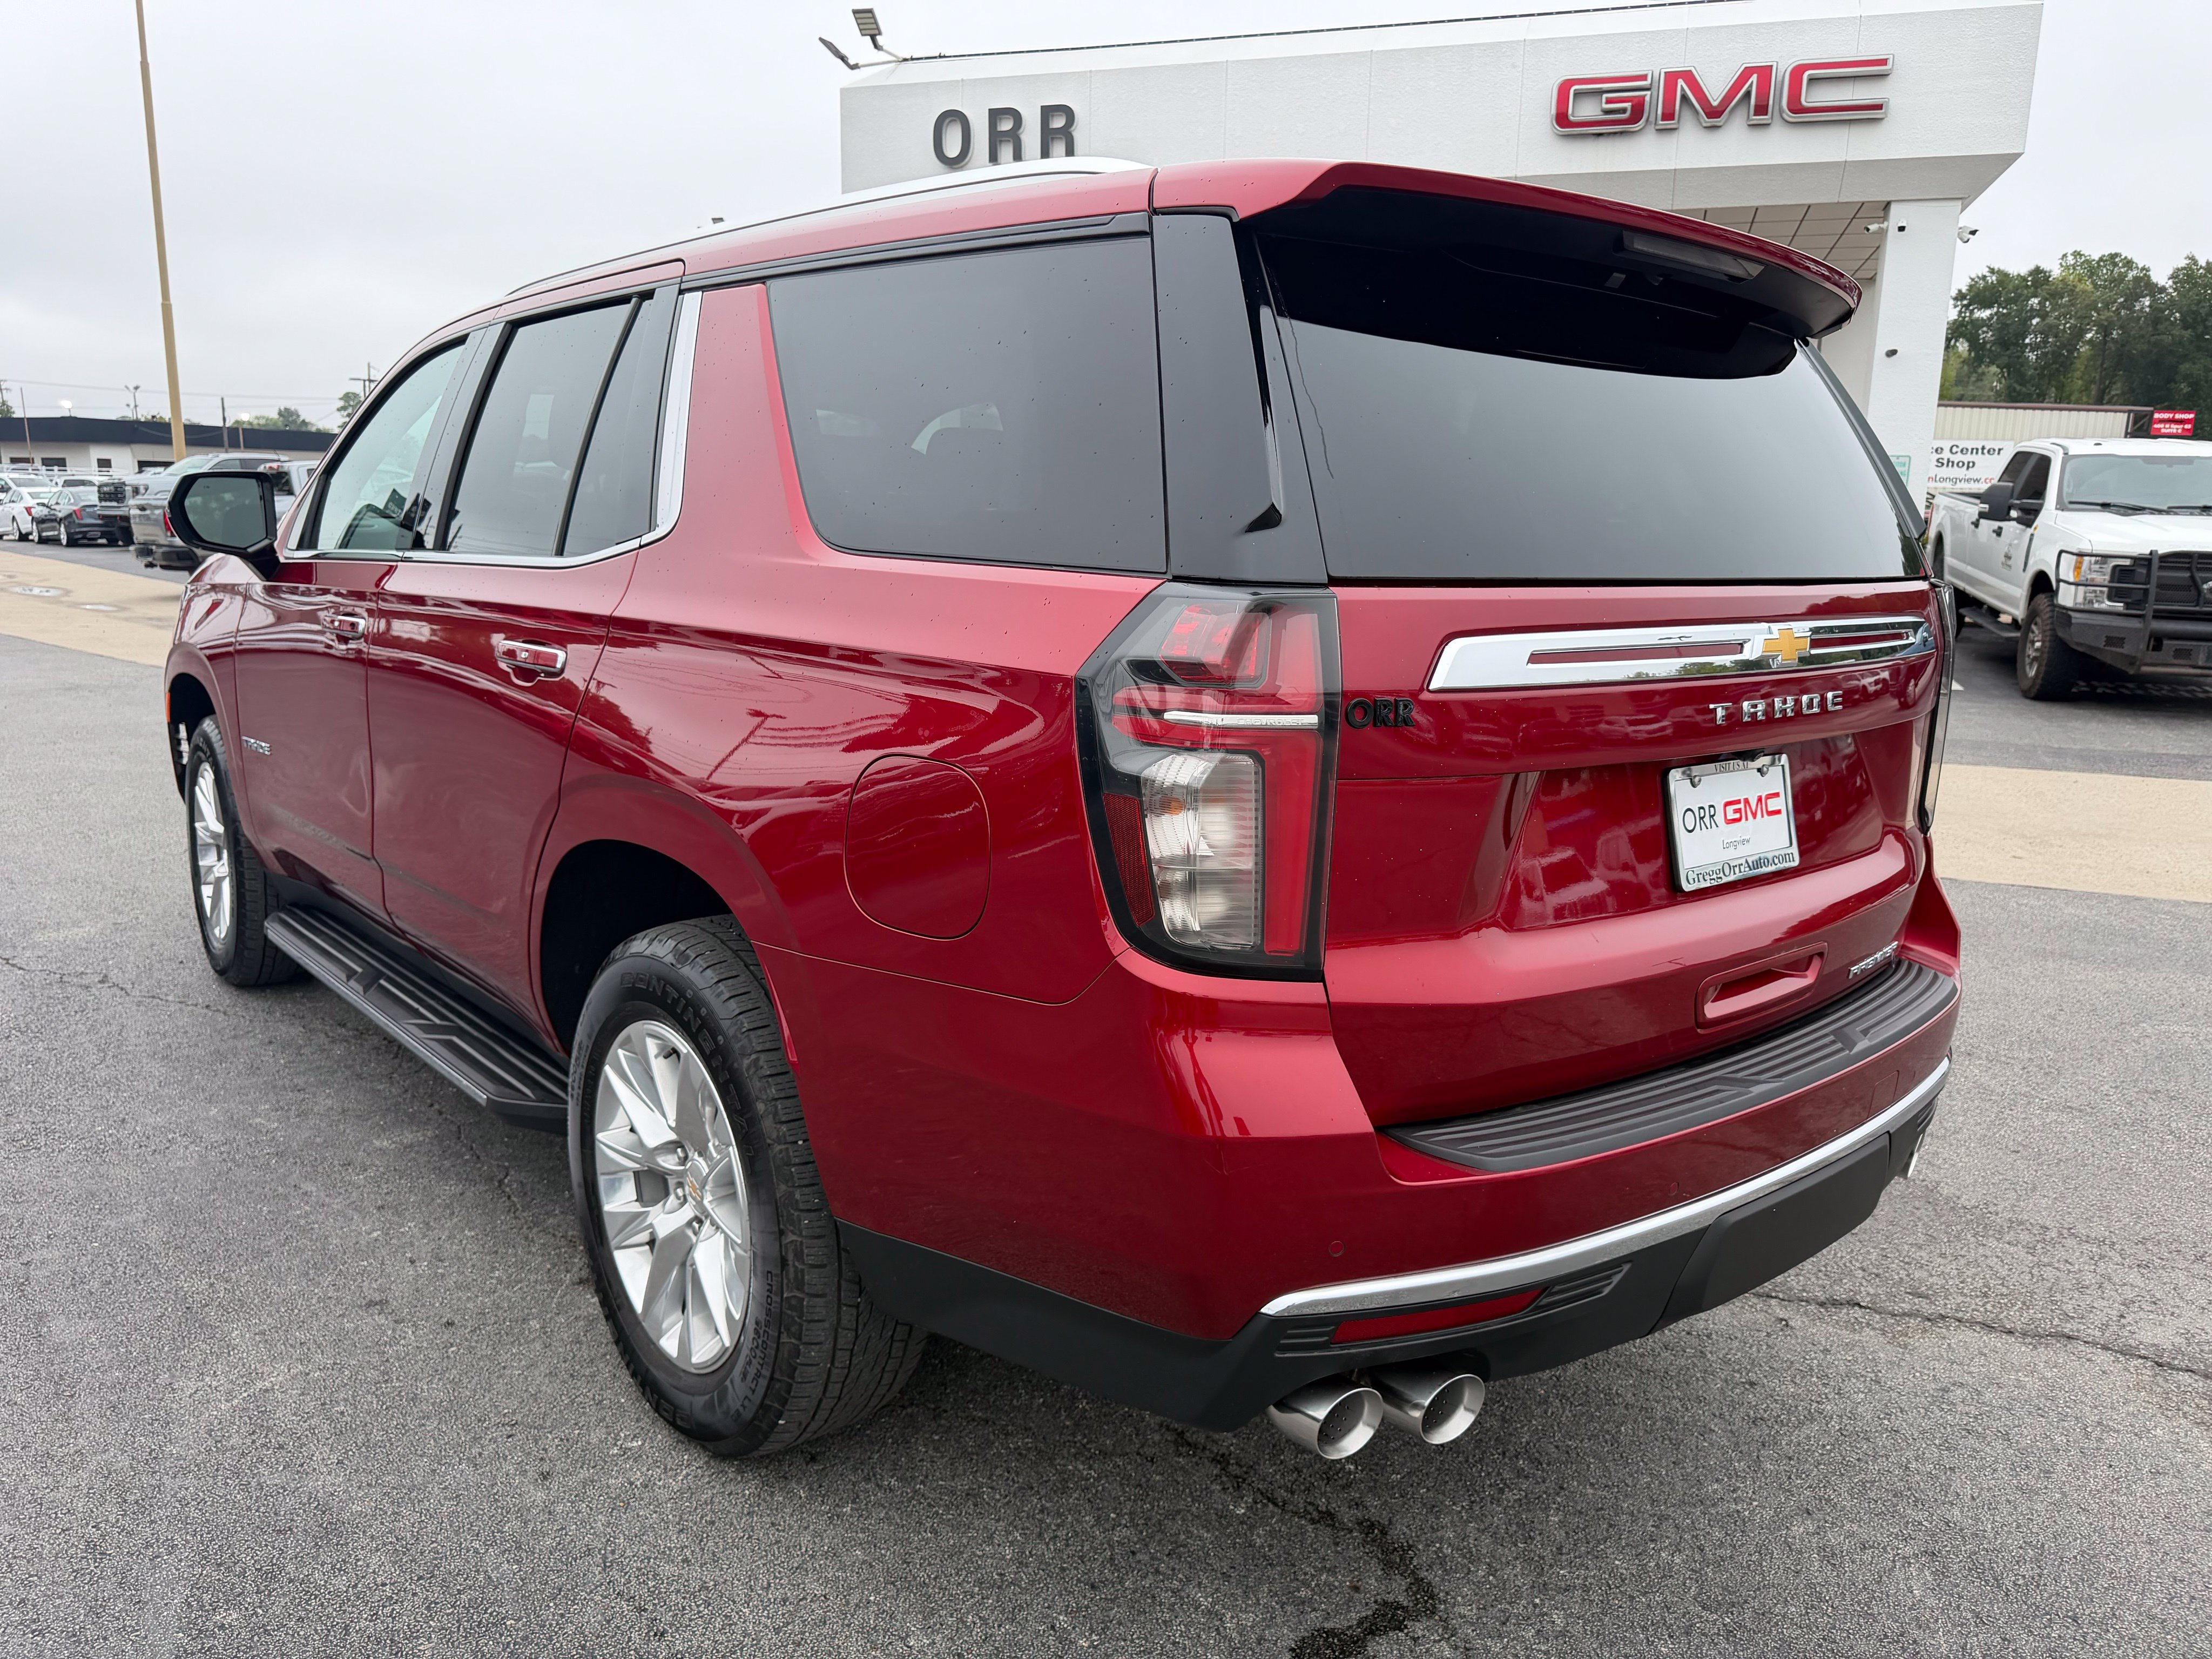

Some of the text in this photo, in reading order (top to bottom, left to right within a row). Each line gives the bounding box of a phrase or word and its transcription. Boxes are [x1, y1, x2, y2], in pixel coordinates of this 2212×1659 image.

[1550, 53, 1894, 136] GMC
[933, 104, 1076, 167] ORR
[1935, 457, 1976, 470] Shop
[1950, 444, 2004, 455] Center
[1237, 718, 1304, 726] CHEVROLET
[1345, 697, 1415, 729] ORR
[1709, 691, 1843, 725] TAHOE
[1714, 762, 1731, 773] VISIT
[1732, 760, 1741, 771] US
[1682, 791, 1782, 833] ORR GMC
[1722, 836, 1751, 850] Longview
[1685, 852, 1795, 885] GreggOrrAuto.com
[1848, 941, 1899, 979] PREMIER
[749, 1270, 773, 1395] CROSSCONTACT
